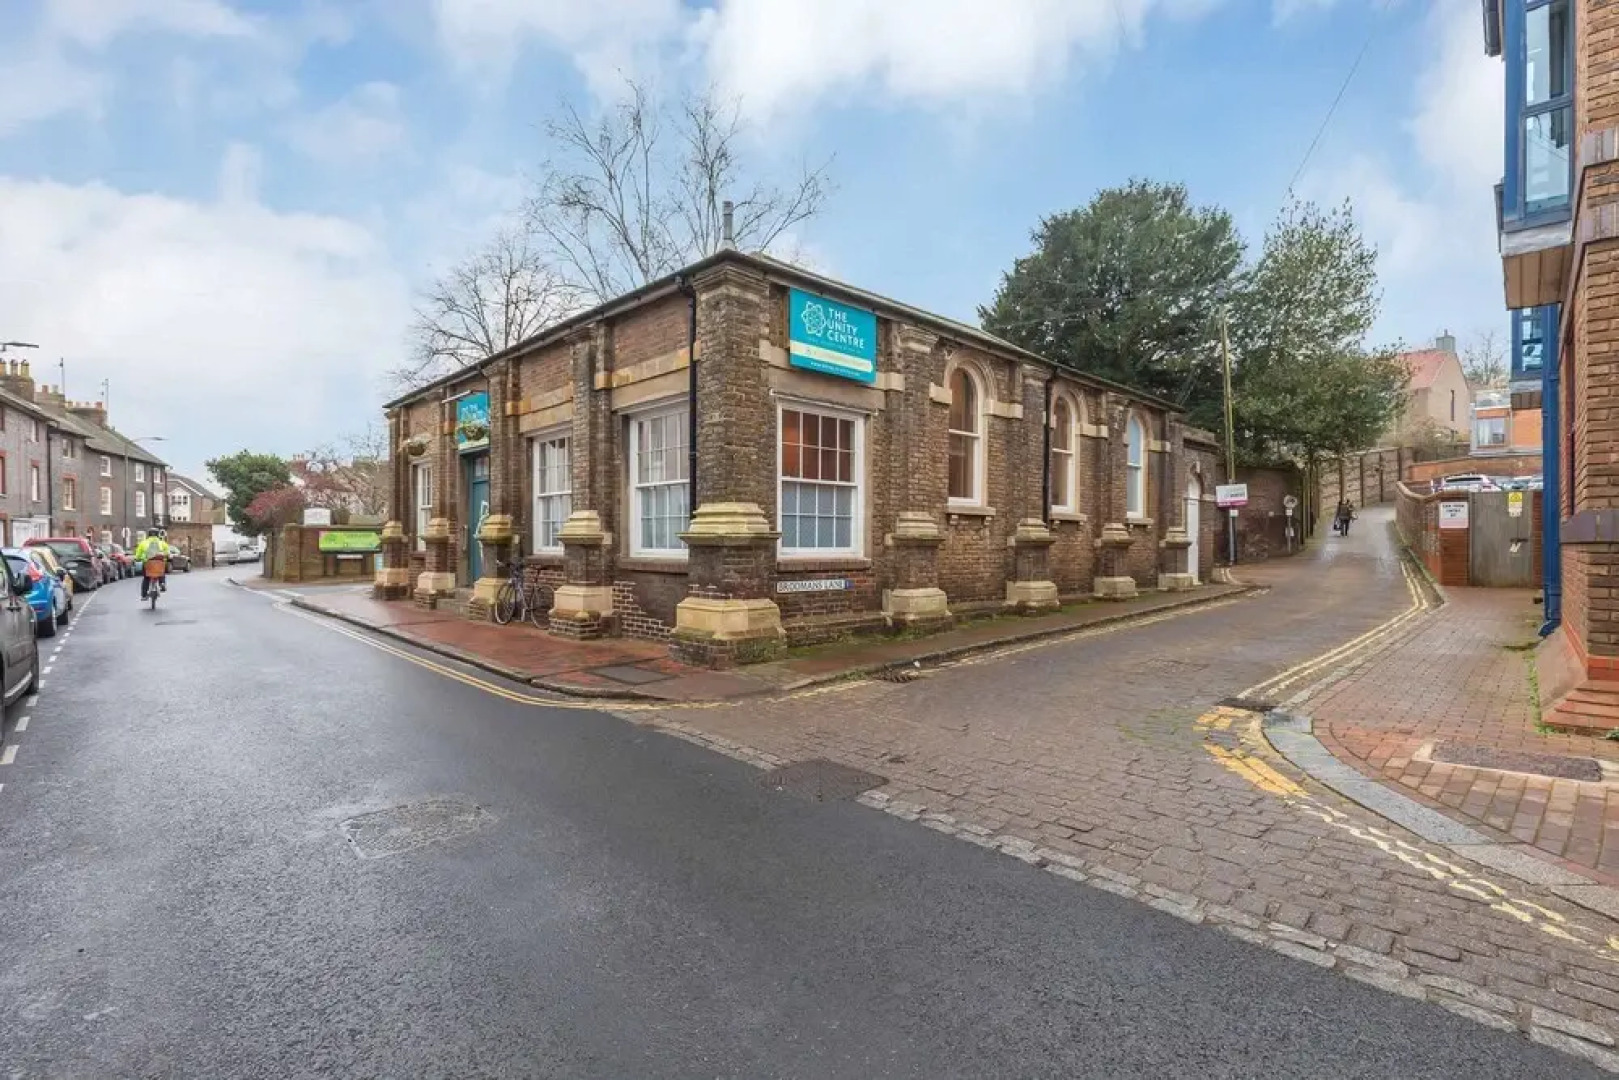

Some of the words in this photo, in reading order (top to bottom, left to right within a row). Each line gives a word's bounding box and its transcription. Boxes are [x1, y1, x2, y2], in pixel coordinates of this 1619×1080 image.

[829, 307, 847, 323] THE
[826, 319, 858, 335] UNITY
[827, 330, 864, 349] CENTRE
